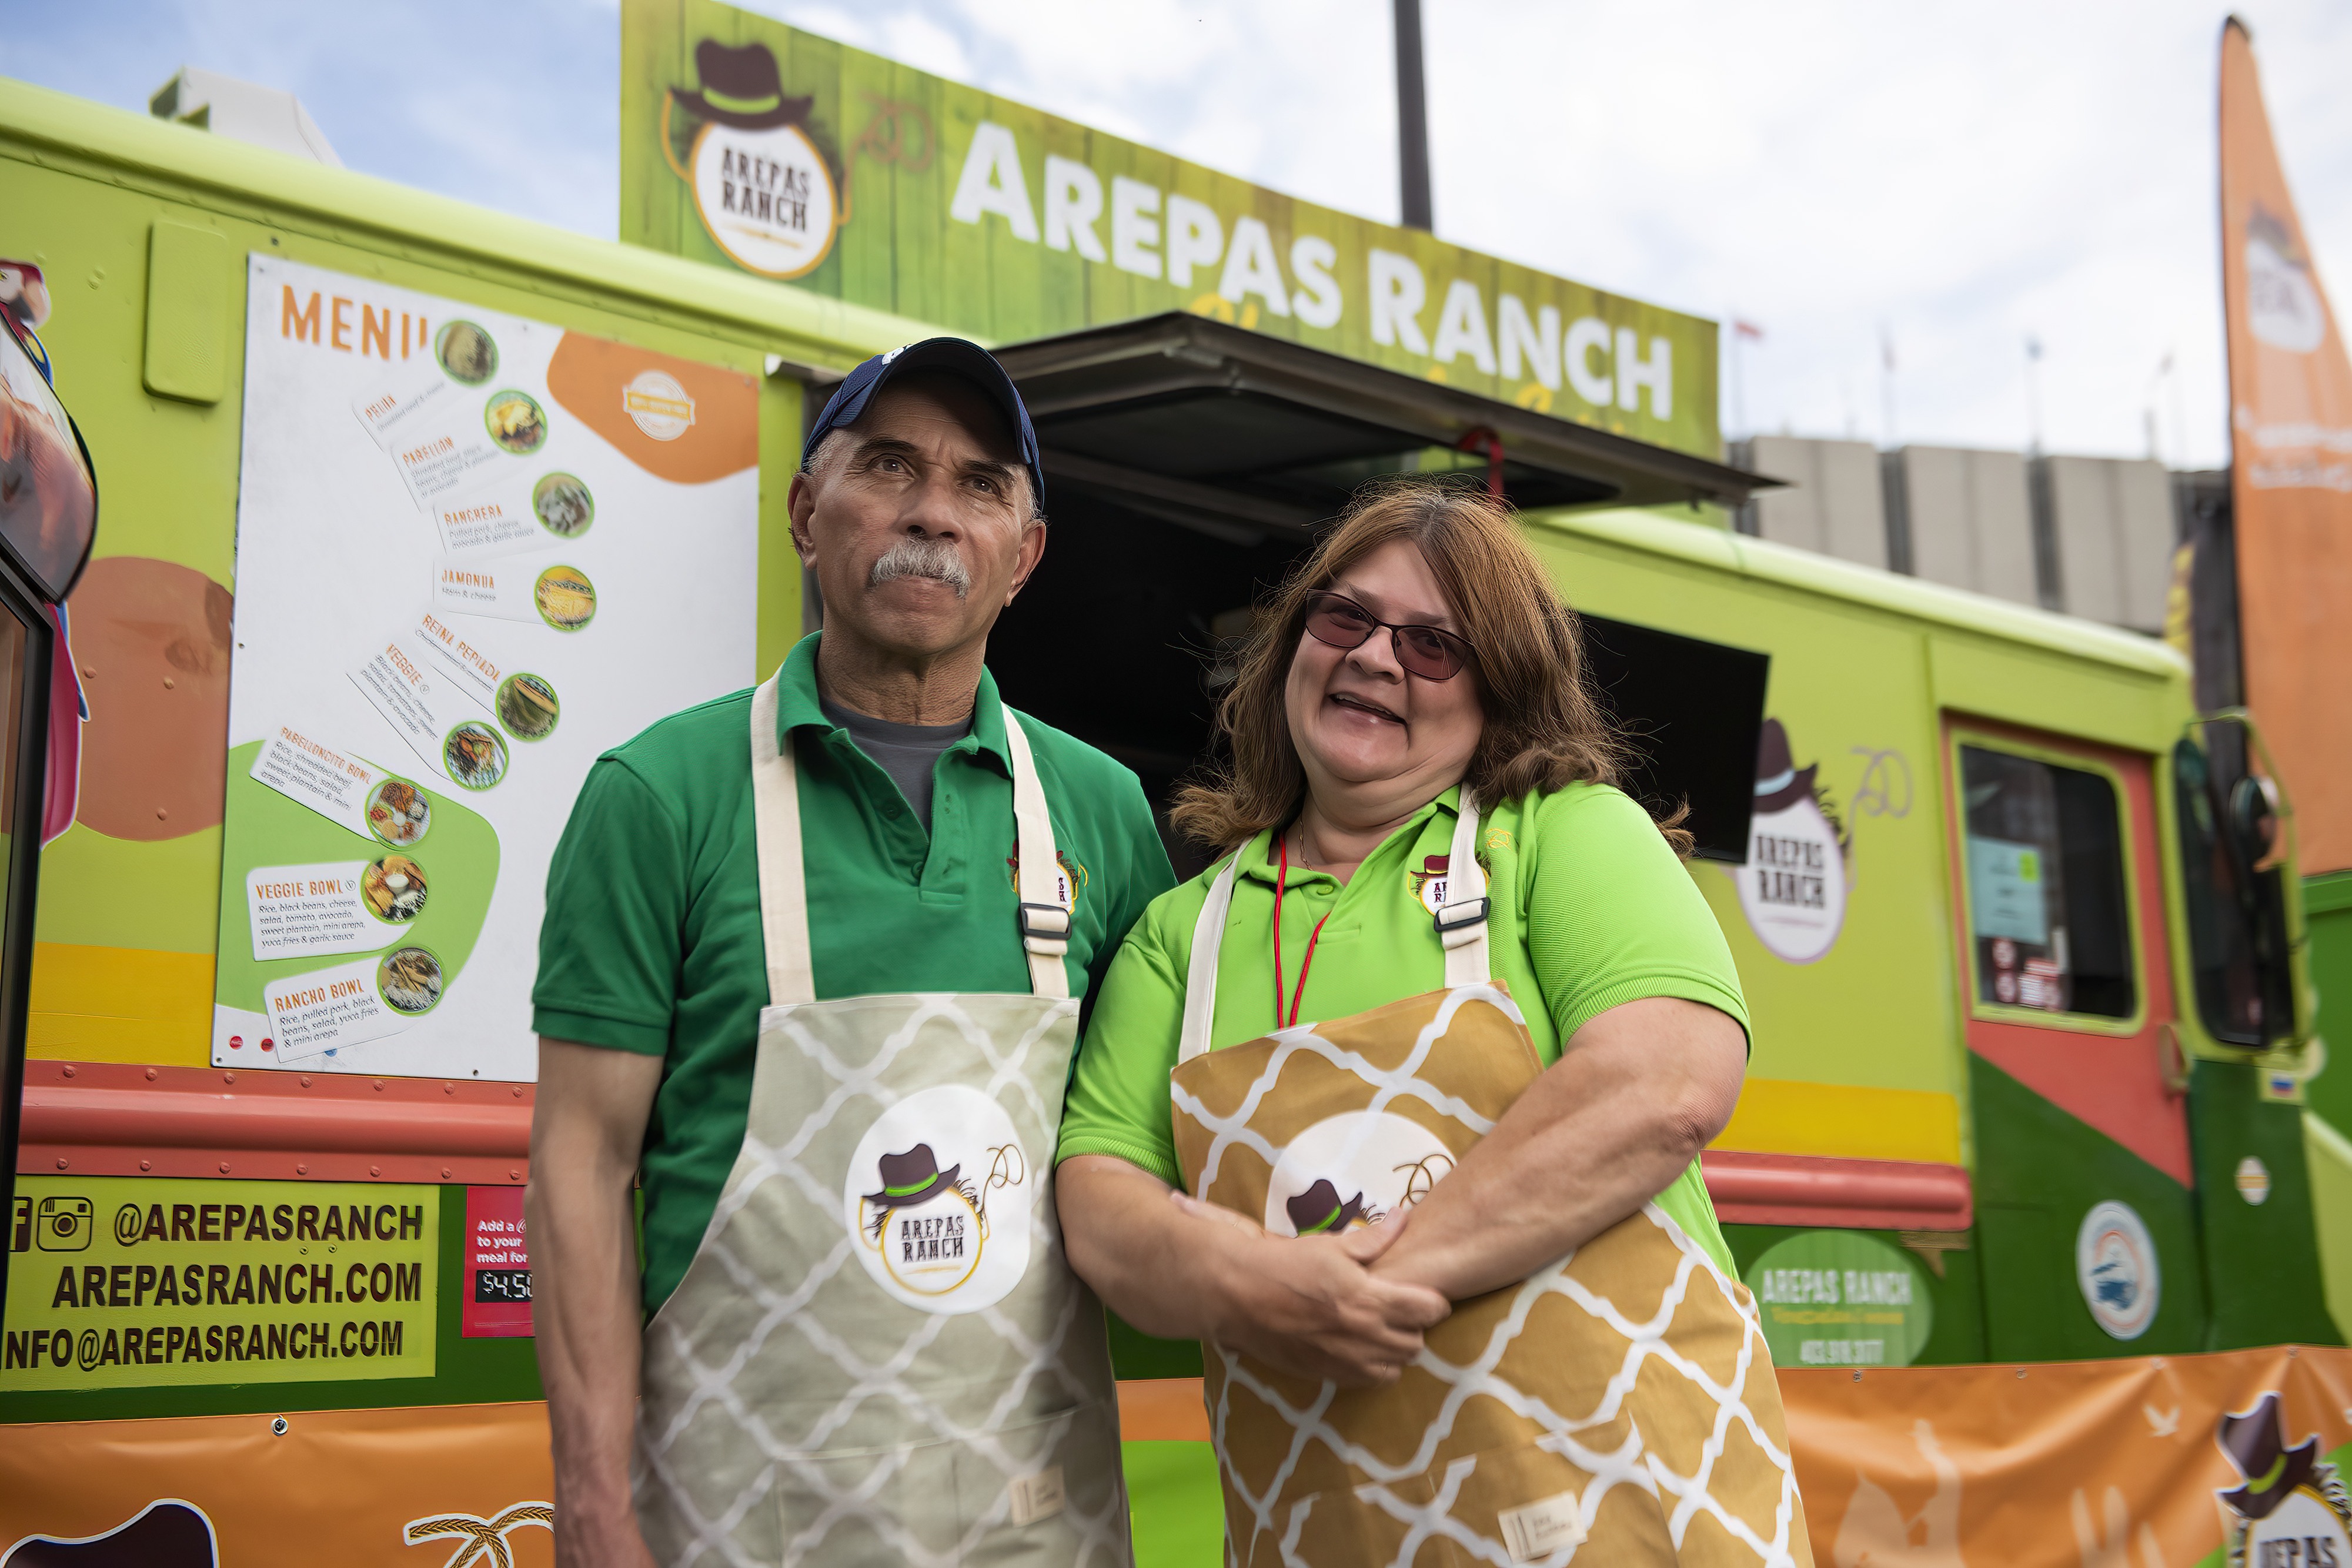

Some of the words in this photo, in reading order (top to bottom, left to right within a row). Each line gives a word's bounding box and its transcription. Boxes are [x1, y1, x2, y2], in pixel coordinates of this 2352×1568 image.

[722, 145, 811, 199] AREPAS
[722, 180, 807, 232] RANCH
[950, 121, 1344, 329] AREPAS
[1368, 248, 1673, 420] RANCH
[445, 504, 502, 527] RANCHERA
[422, 614, 456, 644] REINA
[384, 643, 423, 686] VEGGIE
[280, 727, 346, 768] PABELLONCITO
[346, 763, 372, 783] BOWL
[256, 881, 304, 900] VEGGIE
[309, 878, 343, 896] BOWL
[279, 902, 301, 912] black
[301, 935, 308, 944] &
[332, 933, 355, 942] sauce
[275, 988, 325, 1012] RANCHO
[329, 978, 363, 998] BOWL
[302, 1007, 329, 1021] pulled
[352, 995, 375, 1008] black
[283, 1039, 292, 1048] &
[293, 1034, 312, 1045] mini
[313, 1029, 339, 1042] arepa
[115, 1203, 423, 1247] @AREPASRANCH
[477, 1220, 504, 1232] Add
[506, 1223, 514, 1232] a
[901, 1215, 964, 1241] AREPAS
[477, 1236, 490, 1247] to
[493, 1238, 523, 1252] your
[477, 1251, 507, 1263] meal
[509, 1251, 529, 1263] for
[902, 1237, 964, 1263] RANCH
[52, 1262, 422, 1308] AREPASRANCH.COM
[5, 1320, 404, 1372] NFO@AREPASRANCH.COM
